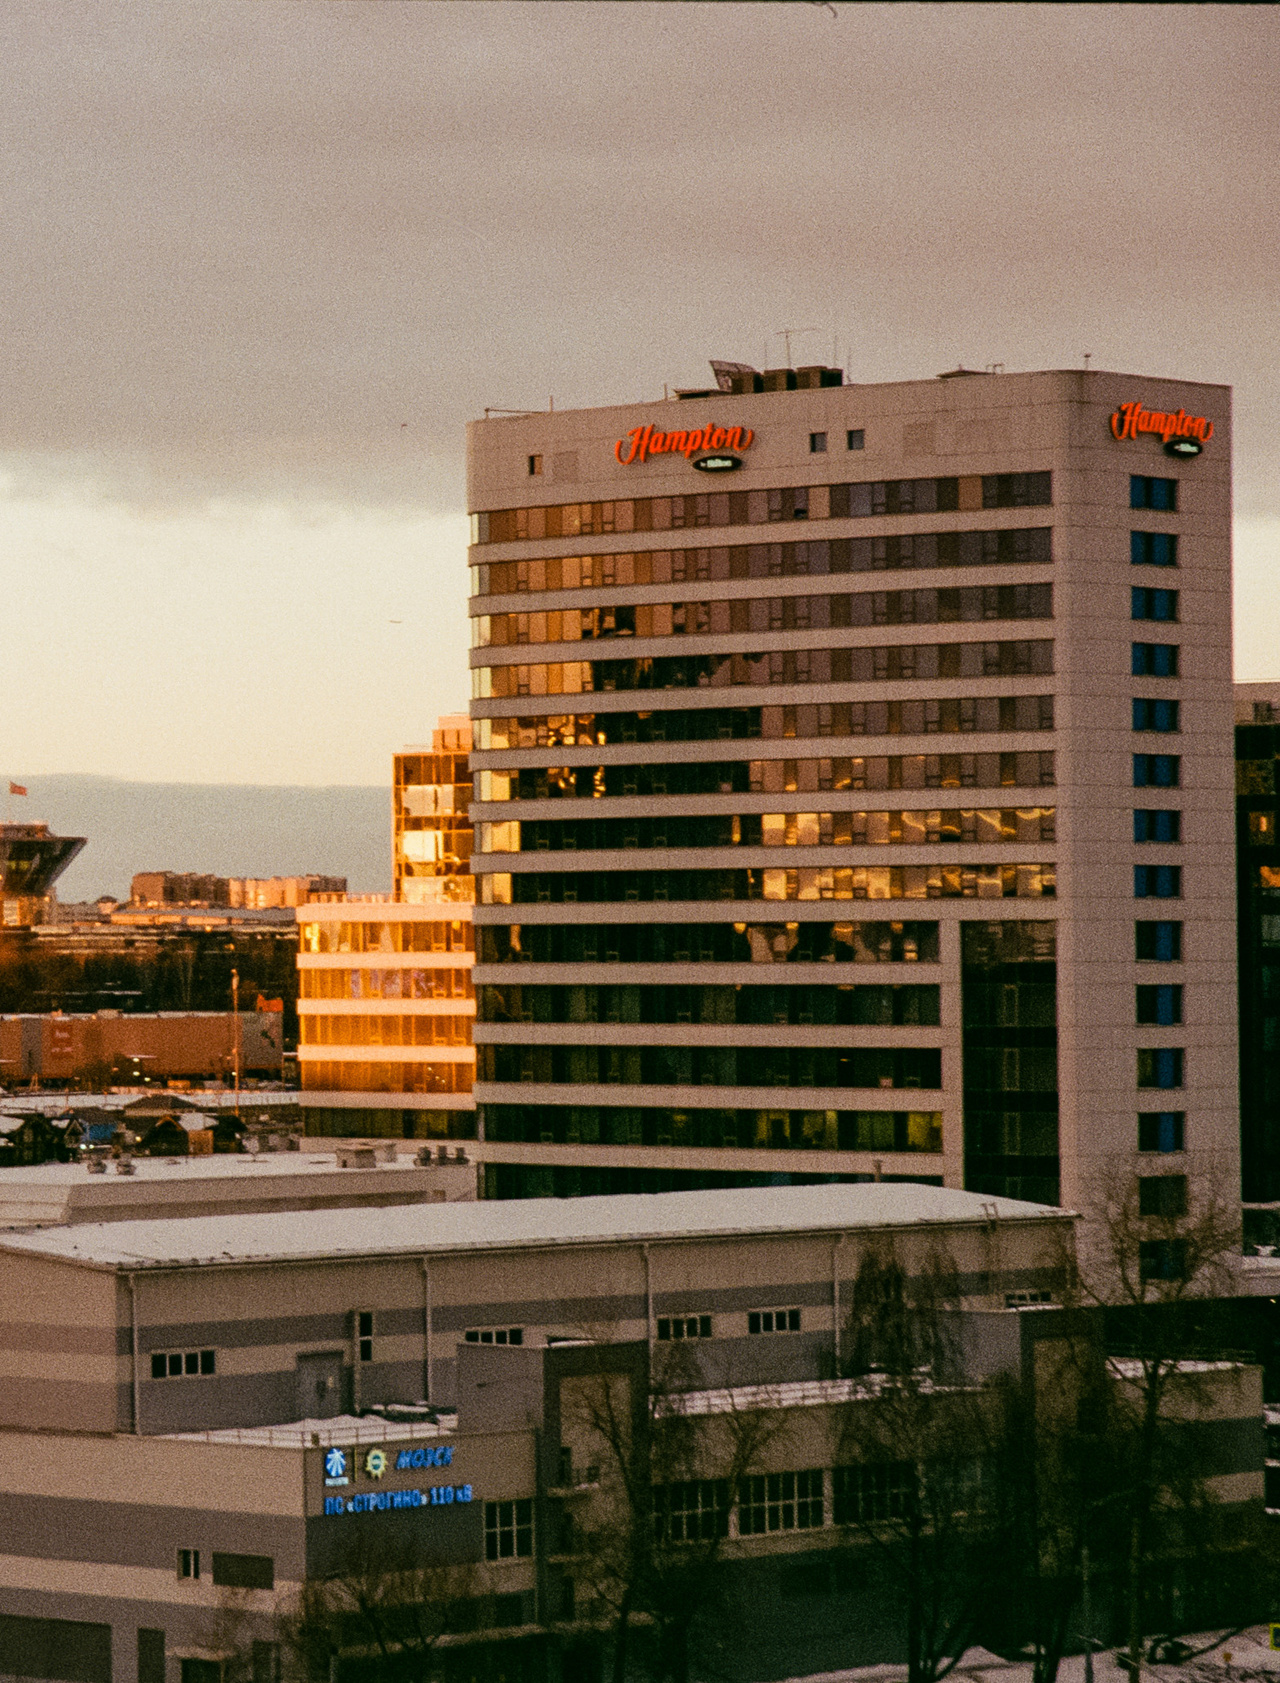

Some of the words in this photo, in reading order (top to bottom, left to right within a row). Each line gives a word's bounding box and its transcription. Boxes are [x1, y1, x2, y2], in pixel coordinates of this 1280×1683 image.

[1111, 401, 1214, 443] Hampton
[614, 422, 755, 466] Hampton
[324, 1495, 344, 1516] ПС
[430, 1485, 454, 1506] 110
